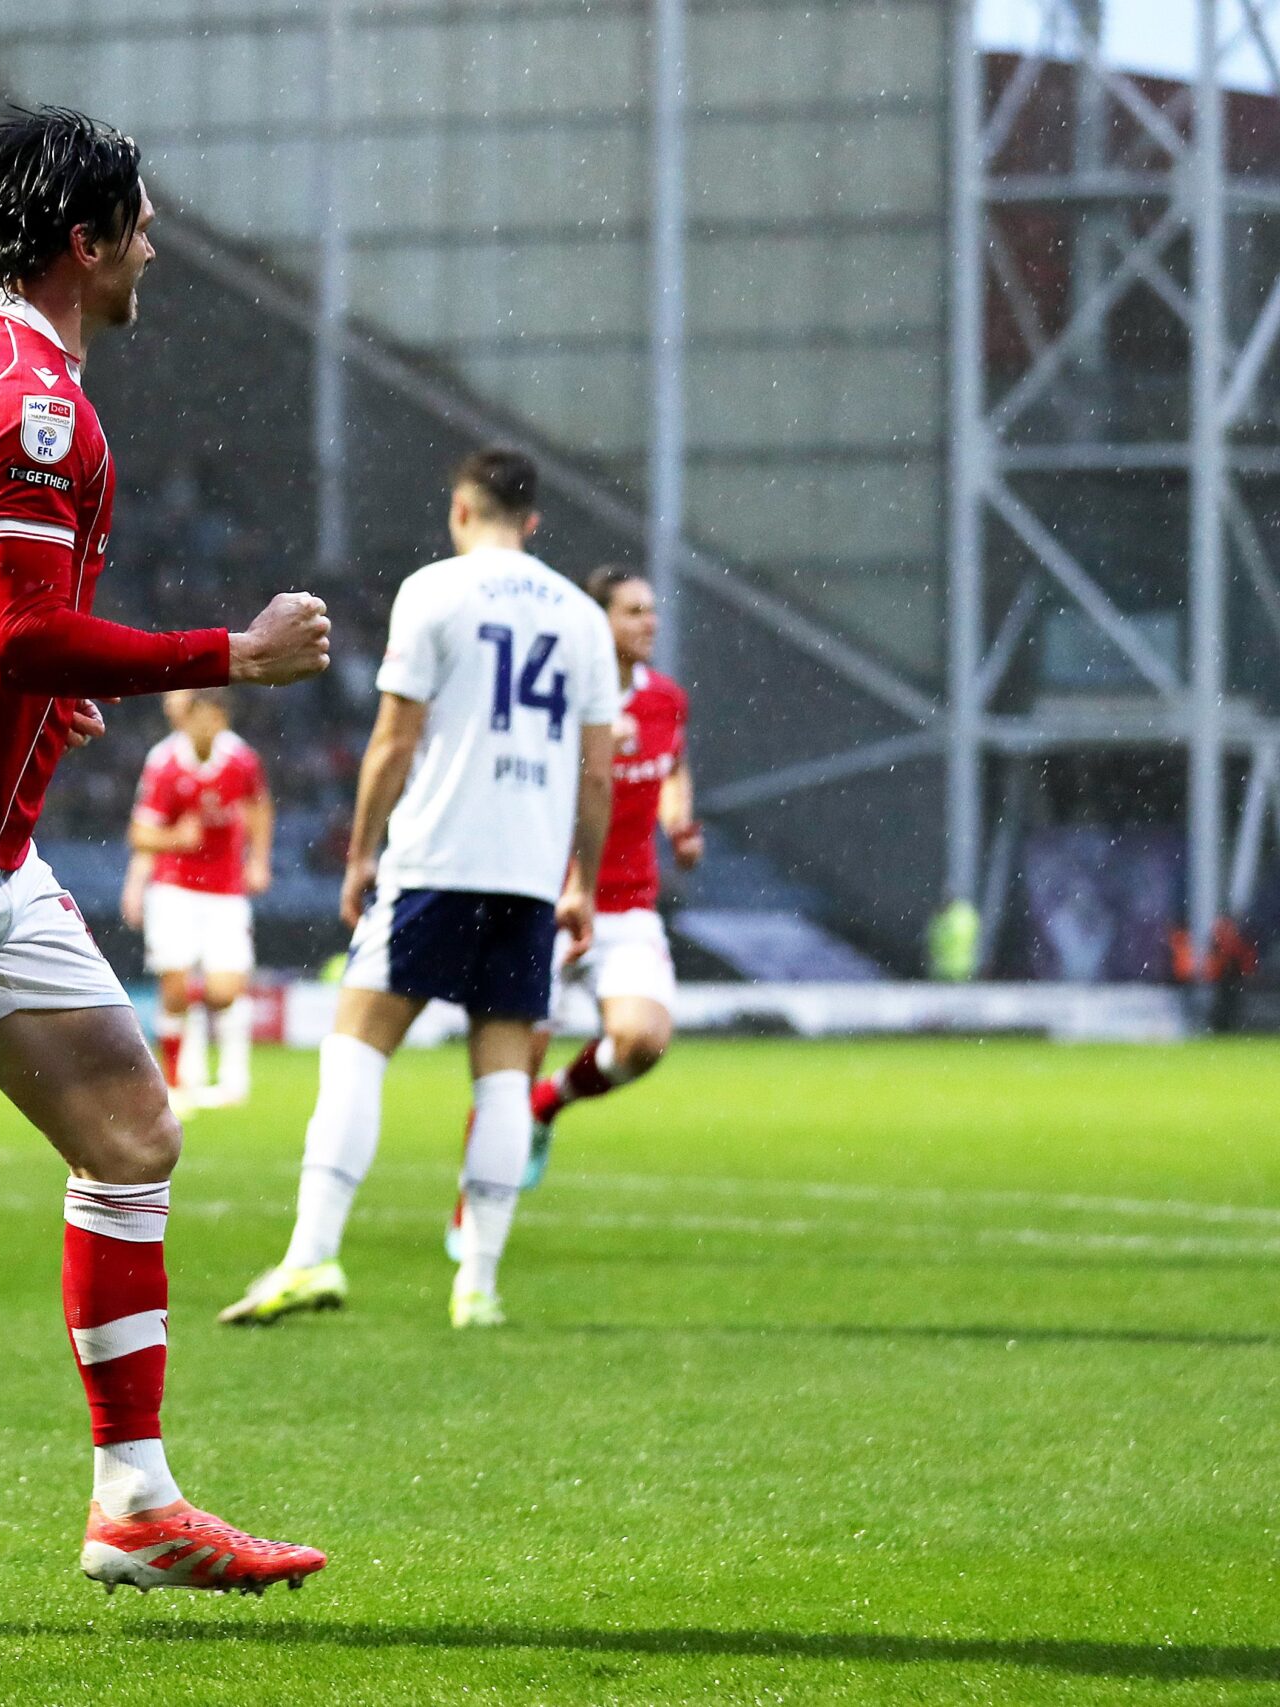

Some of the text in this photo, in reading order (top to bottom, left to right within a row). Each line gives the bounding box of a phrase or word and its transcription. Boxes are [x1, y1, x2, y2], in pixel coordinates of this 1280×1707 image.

[28, 402, 70, 416] sky bet
[37, 446, 53, 457] EFL
[478, 621, 568, 742] 14
